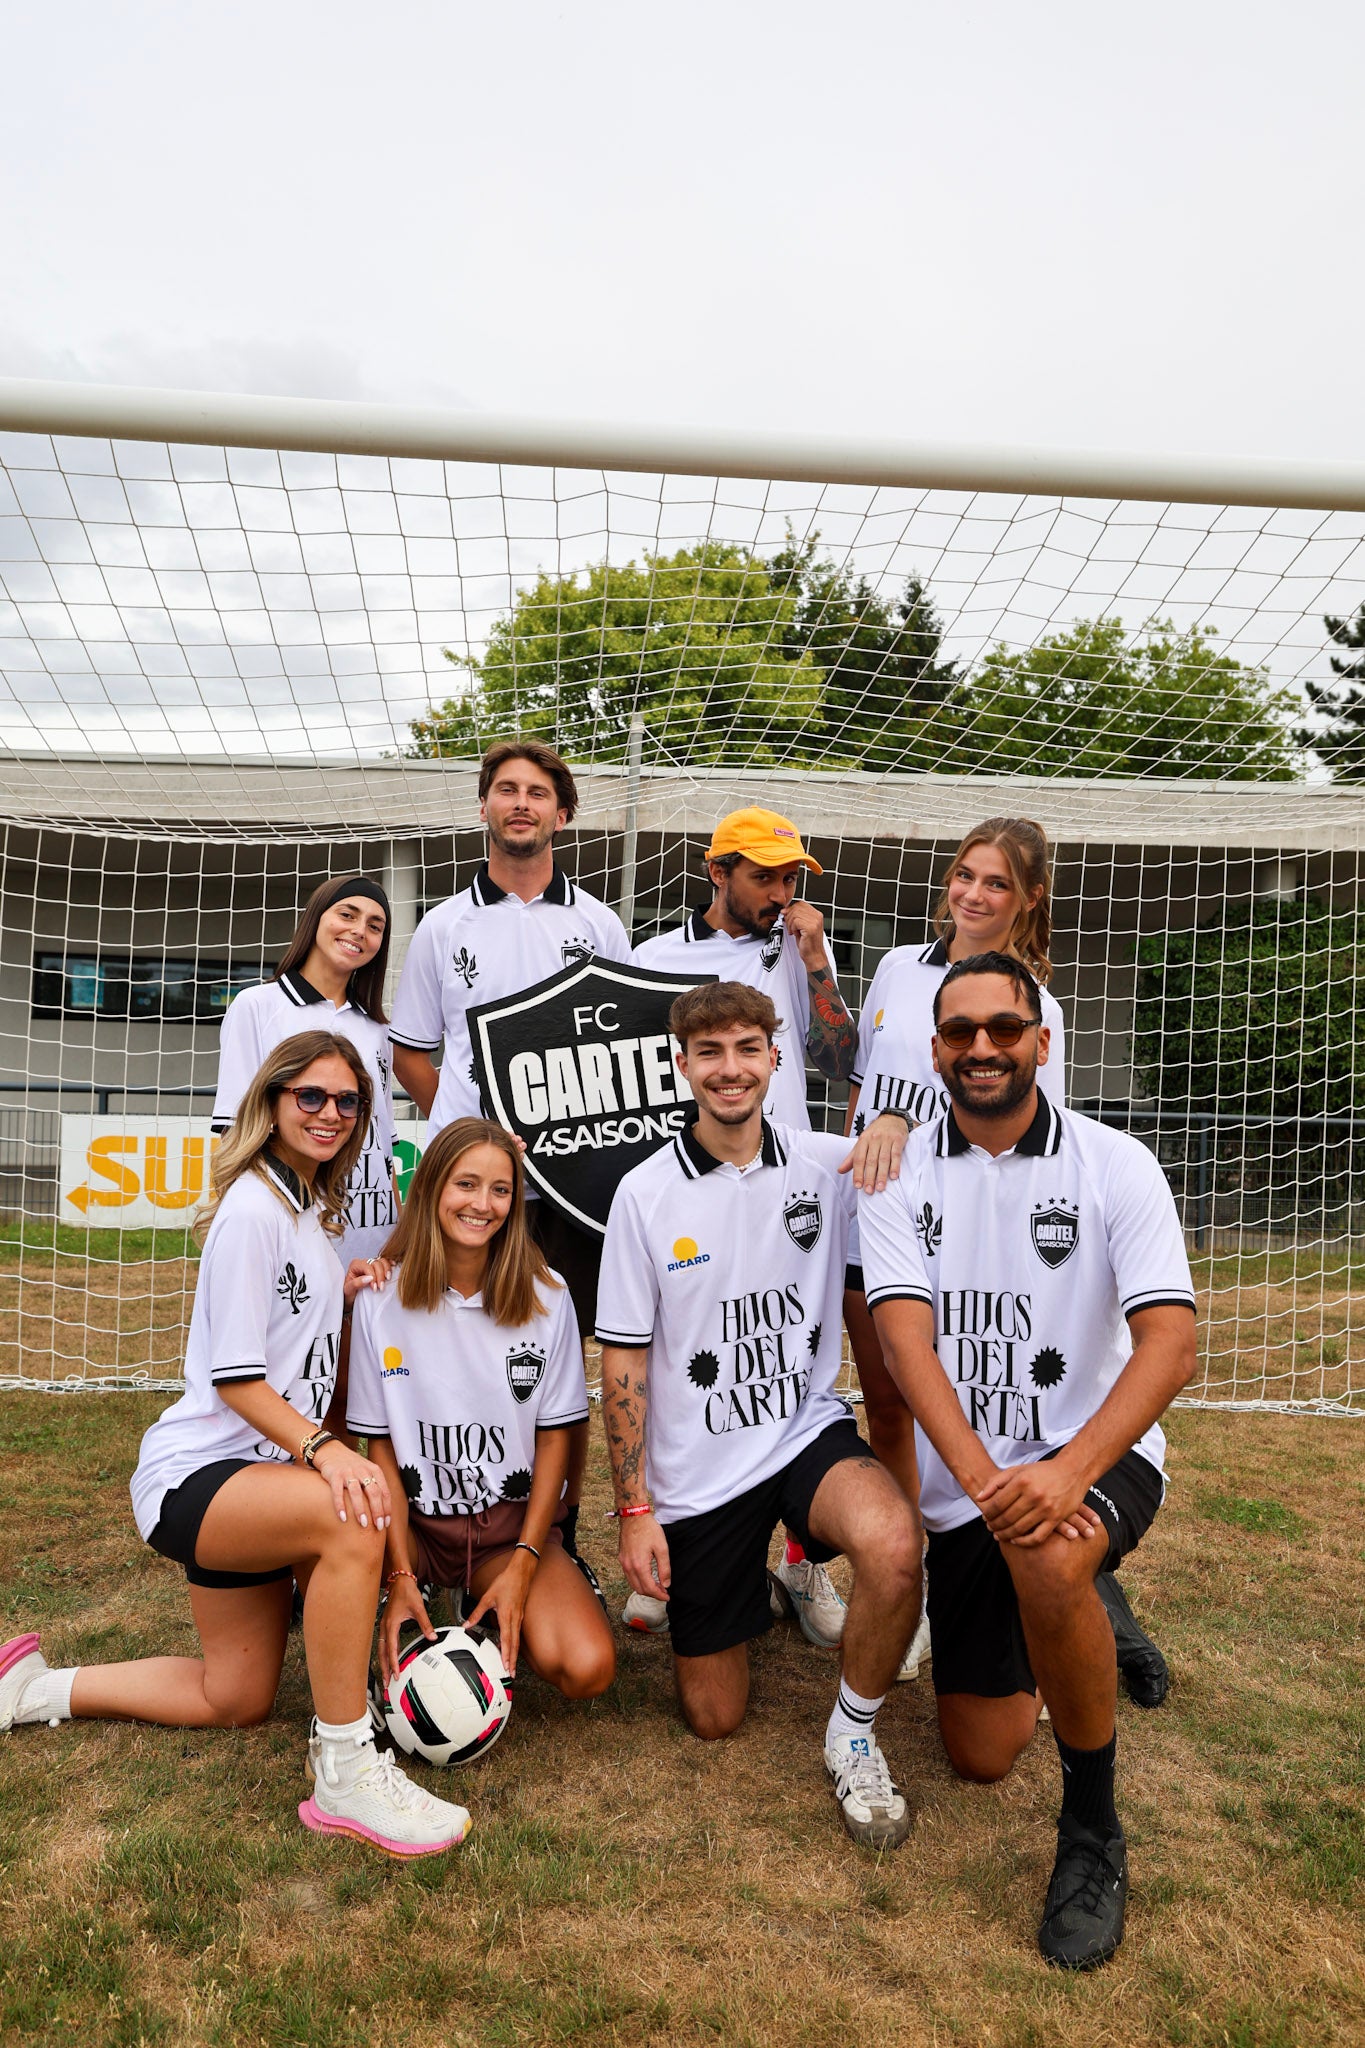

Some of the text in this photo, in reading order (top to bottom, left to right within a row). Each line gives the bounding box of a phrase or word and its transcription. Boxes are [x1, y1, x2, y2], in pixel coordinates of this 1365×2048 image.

[573, 1002, 621, 1036] FC
[532, 1110, 686, 1157] 4SAISONS
[86, 1135, 220, 1210] SU
[788, 1211, 820, 1233] CARTEL
[797, 1207, 808, 1216] FC
[1050, 1216, 1060, 1224] FC
[1036, 1224, 1075, 1242] CARTEL
[667, 1253, 711, 1272] RICARD
[719, 1282, 805, 1344] HIJOS
[939, 1289, 1032, 1342] HIJOS
[380, 1367, 410, 1379] IARD
[511, 1365, 539, 1381] CARTEL
[523, 1358, 532, 1366] FC
[733, 1332, 798, 1385] DEL
[956, 1337, 1022, 1390] DEL
[705, 1367, 813, 1436] CARTE
[954, 1386, 1048, 1442] RTEL
[416, 1419, 506, 1467] HIJOS
[431, 1465, 489, 1501] DEL
